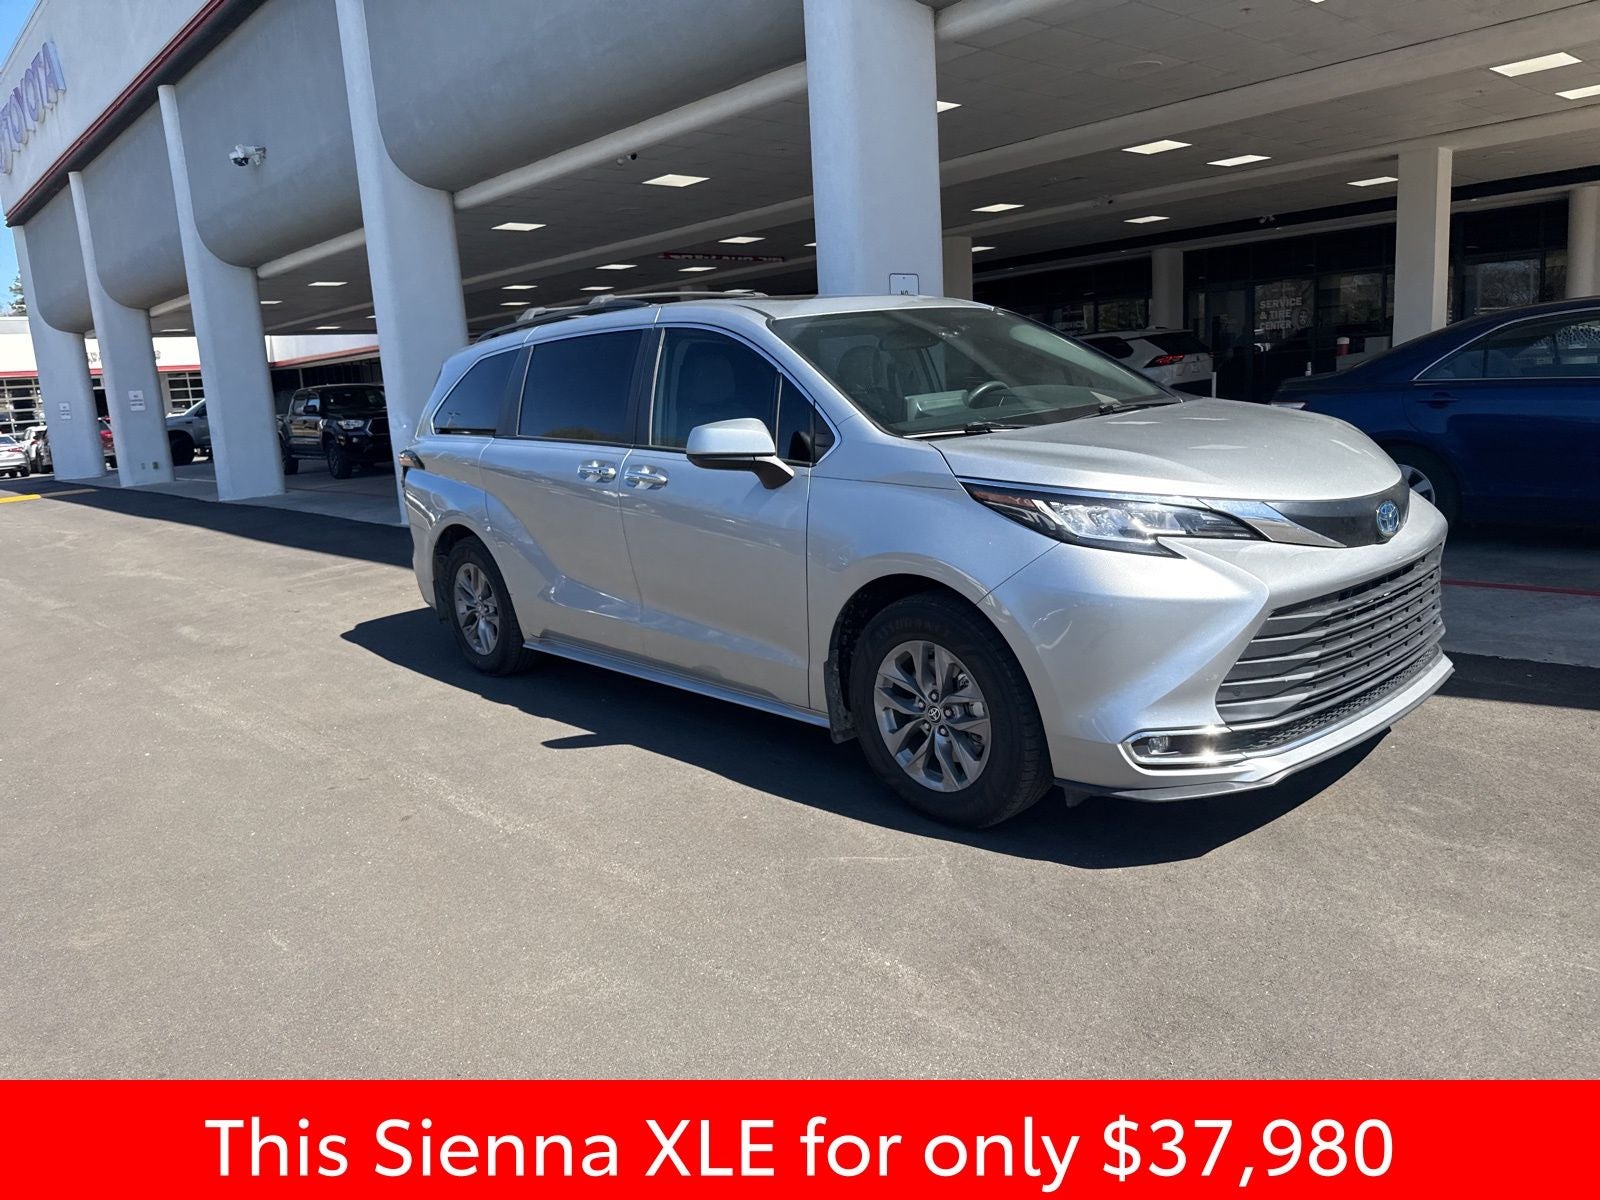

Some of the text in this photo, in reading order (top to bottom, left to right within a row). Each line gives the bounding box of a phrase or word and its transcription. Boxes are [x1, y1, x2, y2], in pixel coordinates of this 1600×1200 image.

[1, 41, 66, 152] TOYOTA
[1260, 296, 1303, 310] SERVICE
[1260, 309, 1292, 320] & TIRE
[1260, 320, 1292, 331] CENTER
